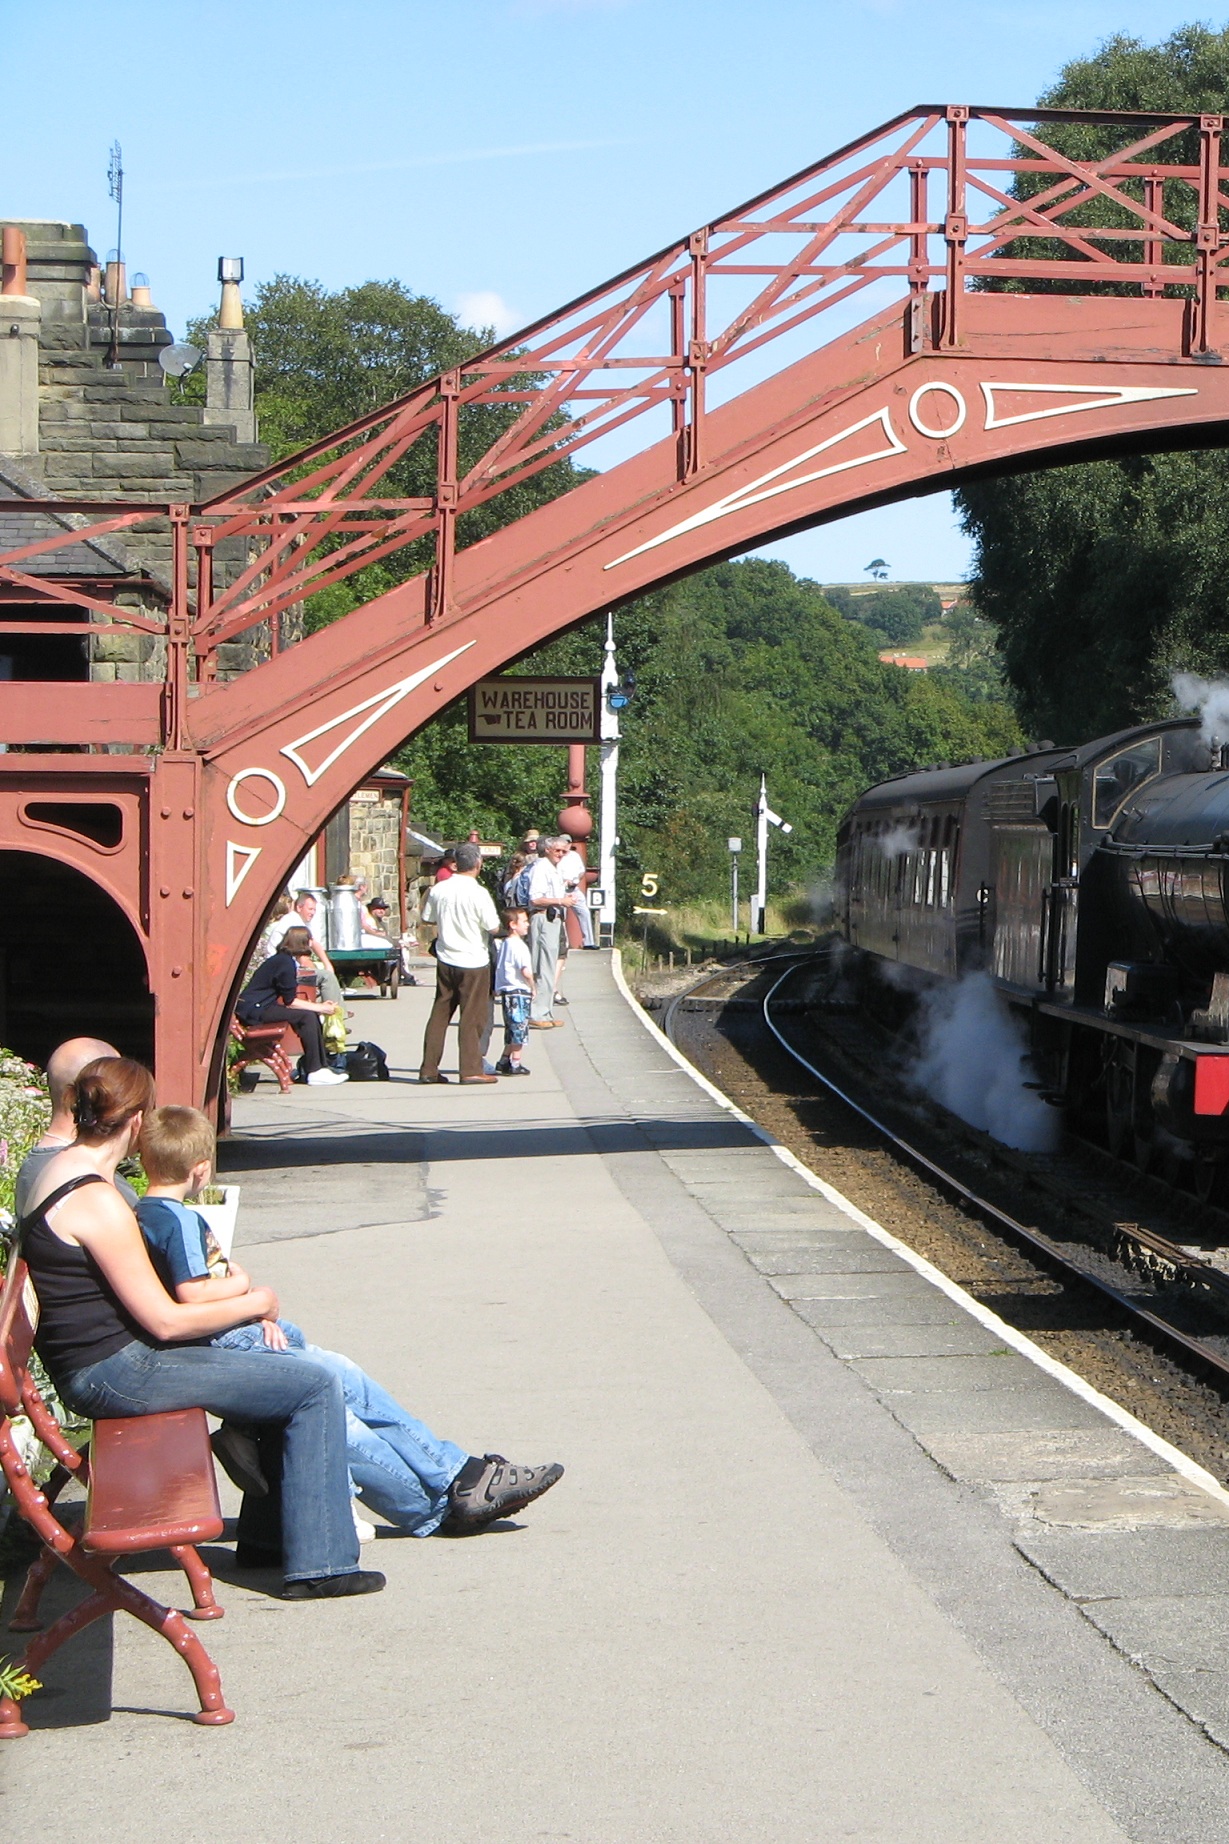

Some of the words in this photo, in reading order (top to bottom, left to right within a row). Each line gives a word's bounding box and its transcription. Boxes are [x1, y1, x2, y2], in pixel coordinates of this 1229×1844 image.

[481, 691, 590, 709] WAREHOUSE
[503, 711, 537, 729] TEA
[545, 711, 592, 729] ROOM
[641, 873, 659, 897] 5
[592, 891, 603, 905] B
